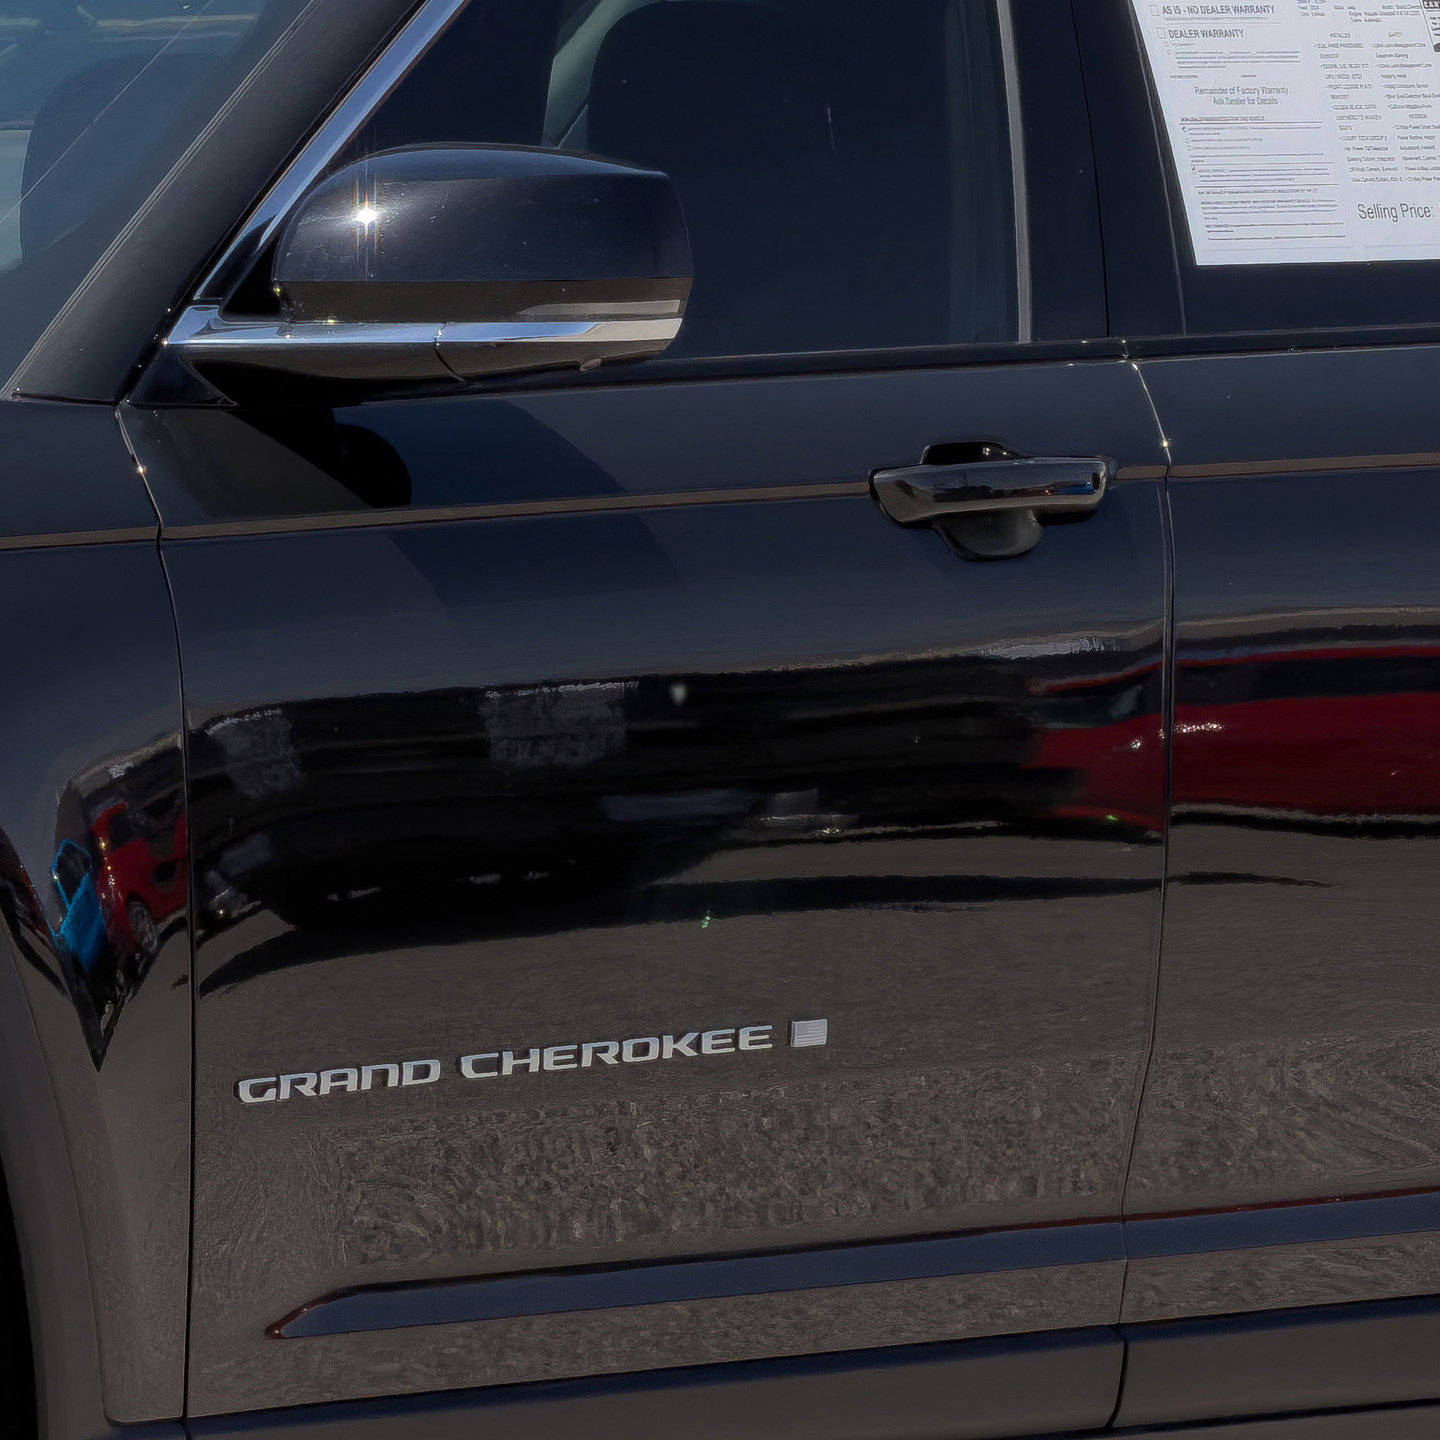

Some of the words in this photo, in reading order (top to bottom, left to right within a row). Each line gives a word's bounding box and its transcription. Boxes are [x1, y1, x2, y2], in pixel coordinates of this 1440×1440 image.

[1200, 6, 1232, 14] DEALER
[1233, 5, 1275, 14] WARRANTY
[1168, 30, 1200, 39] DEALER
[1200, 29, 1244, 38] WARRANTY
[1357, 202, 1399, 223] Selling
[1399, 202, 1435, 219] Price:
[237, 1058, 441, 1104] GRAND
[460, 1024, 773, 1080] CHEROKEE
